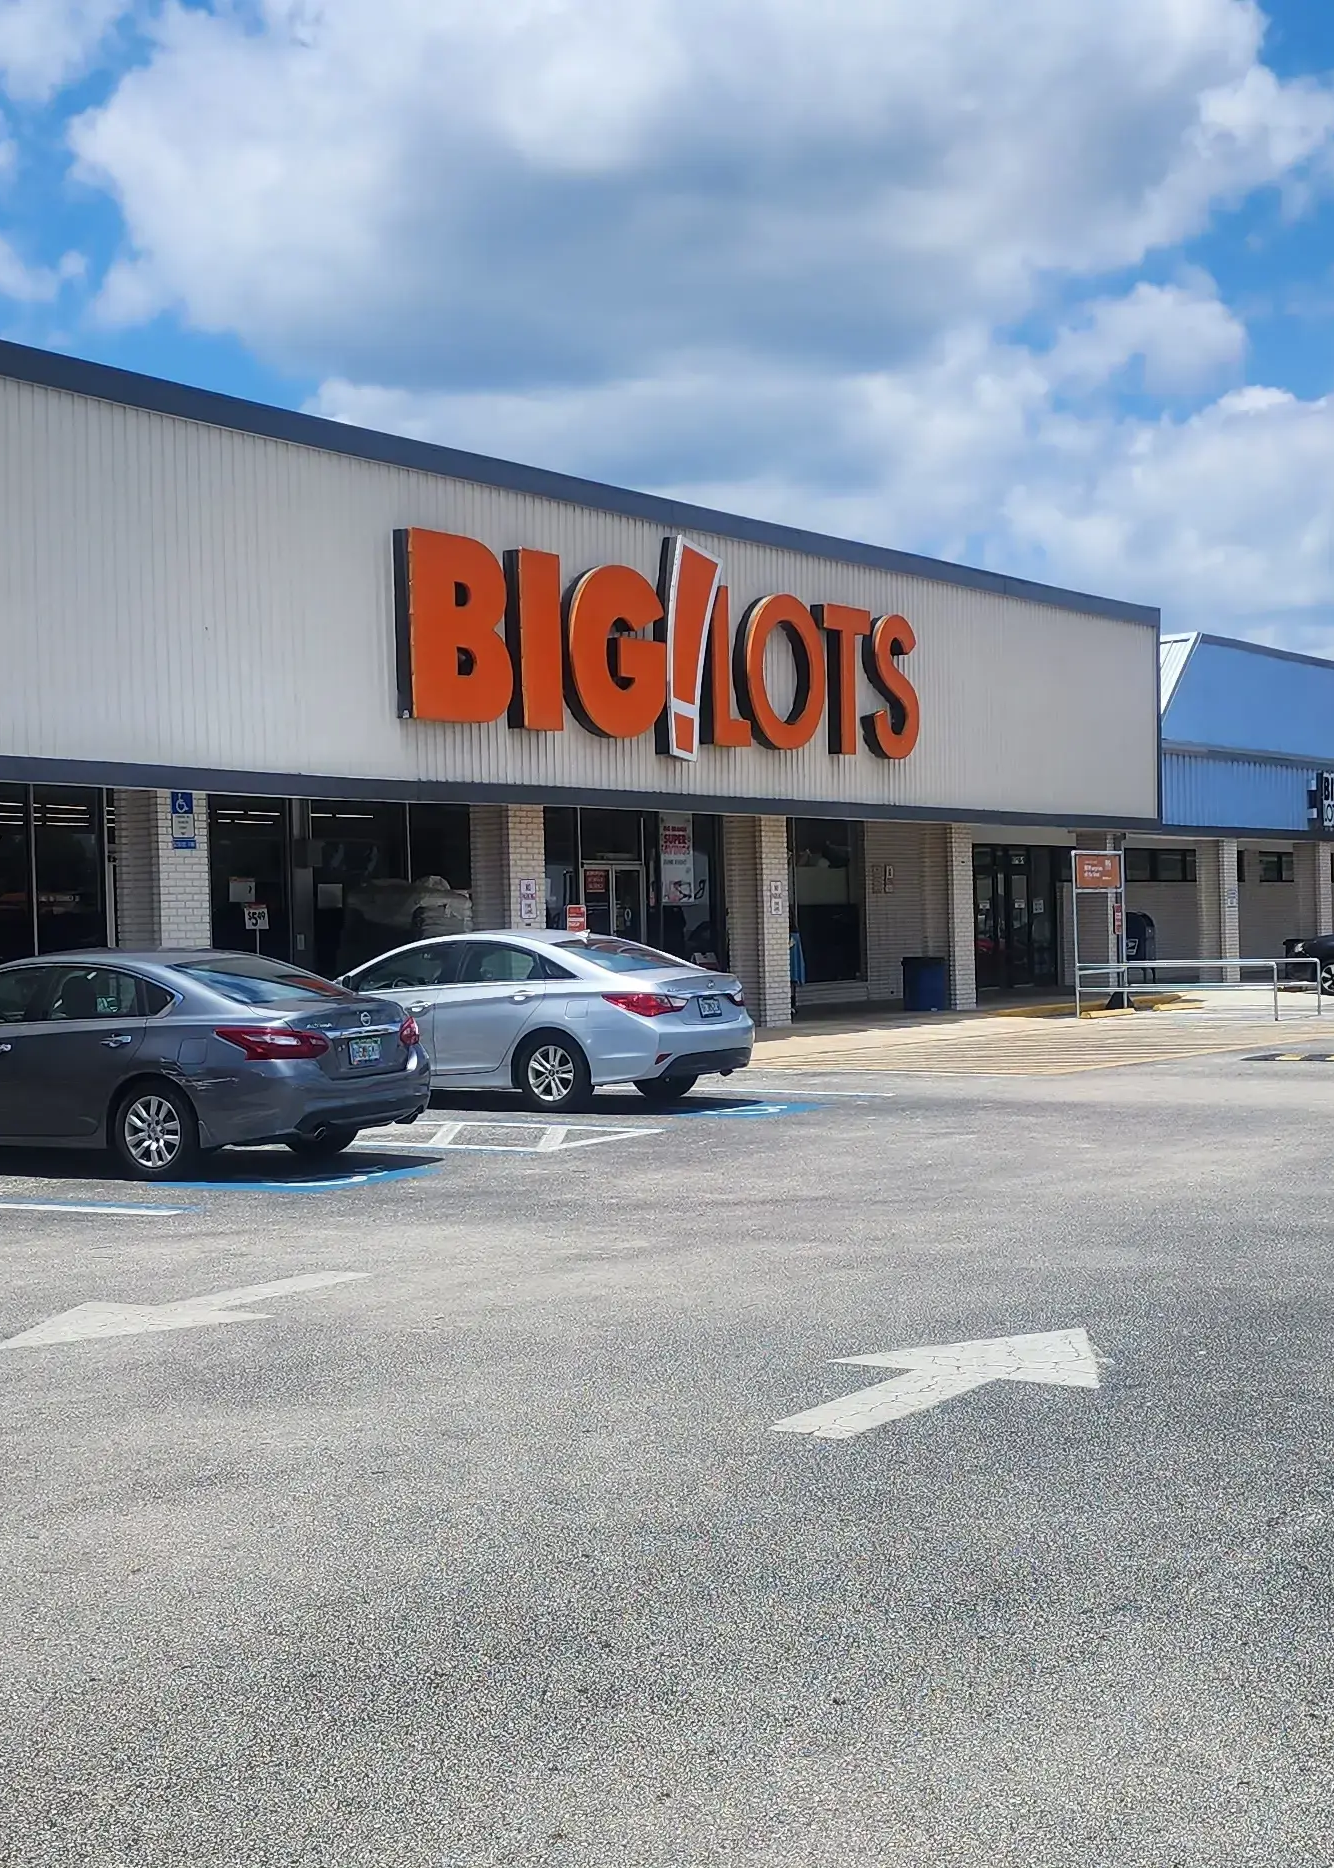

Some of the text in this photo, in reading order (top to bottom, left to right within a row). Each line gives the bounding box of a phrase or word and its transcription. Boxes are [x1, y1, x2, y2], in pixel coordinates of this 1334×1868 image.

[394, 527, 667, 738] BIG
[699, 585, 919, 759] LOTS
[664, 833, 687, 845] SUPER
[661, 844, 690, 855] SAVINGS
